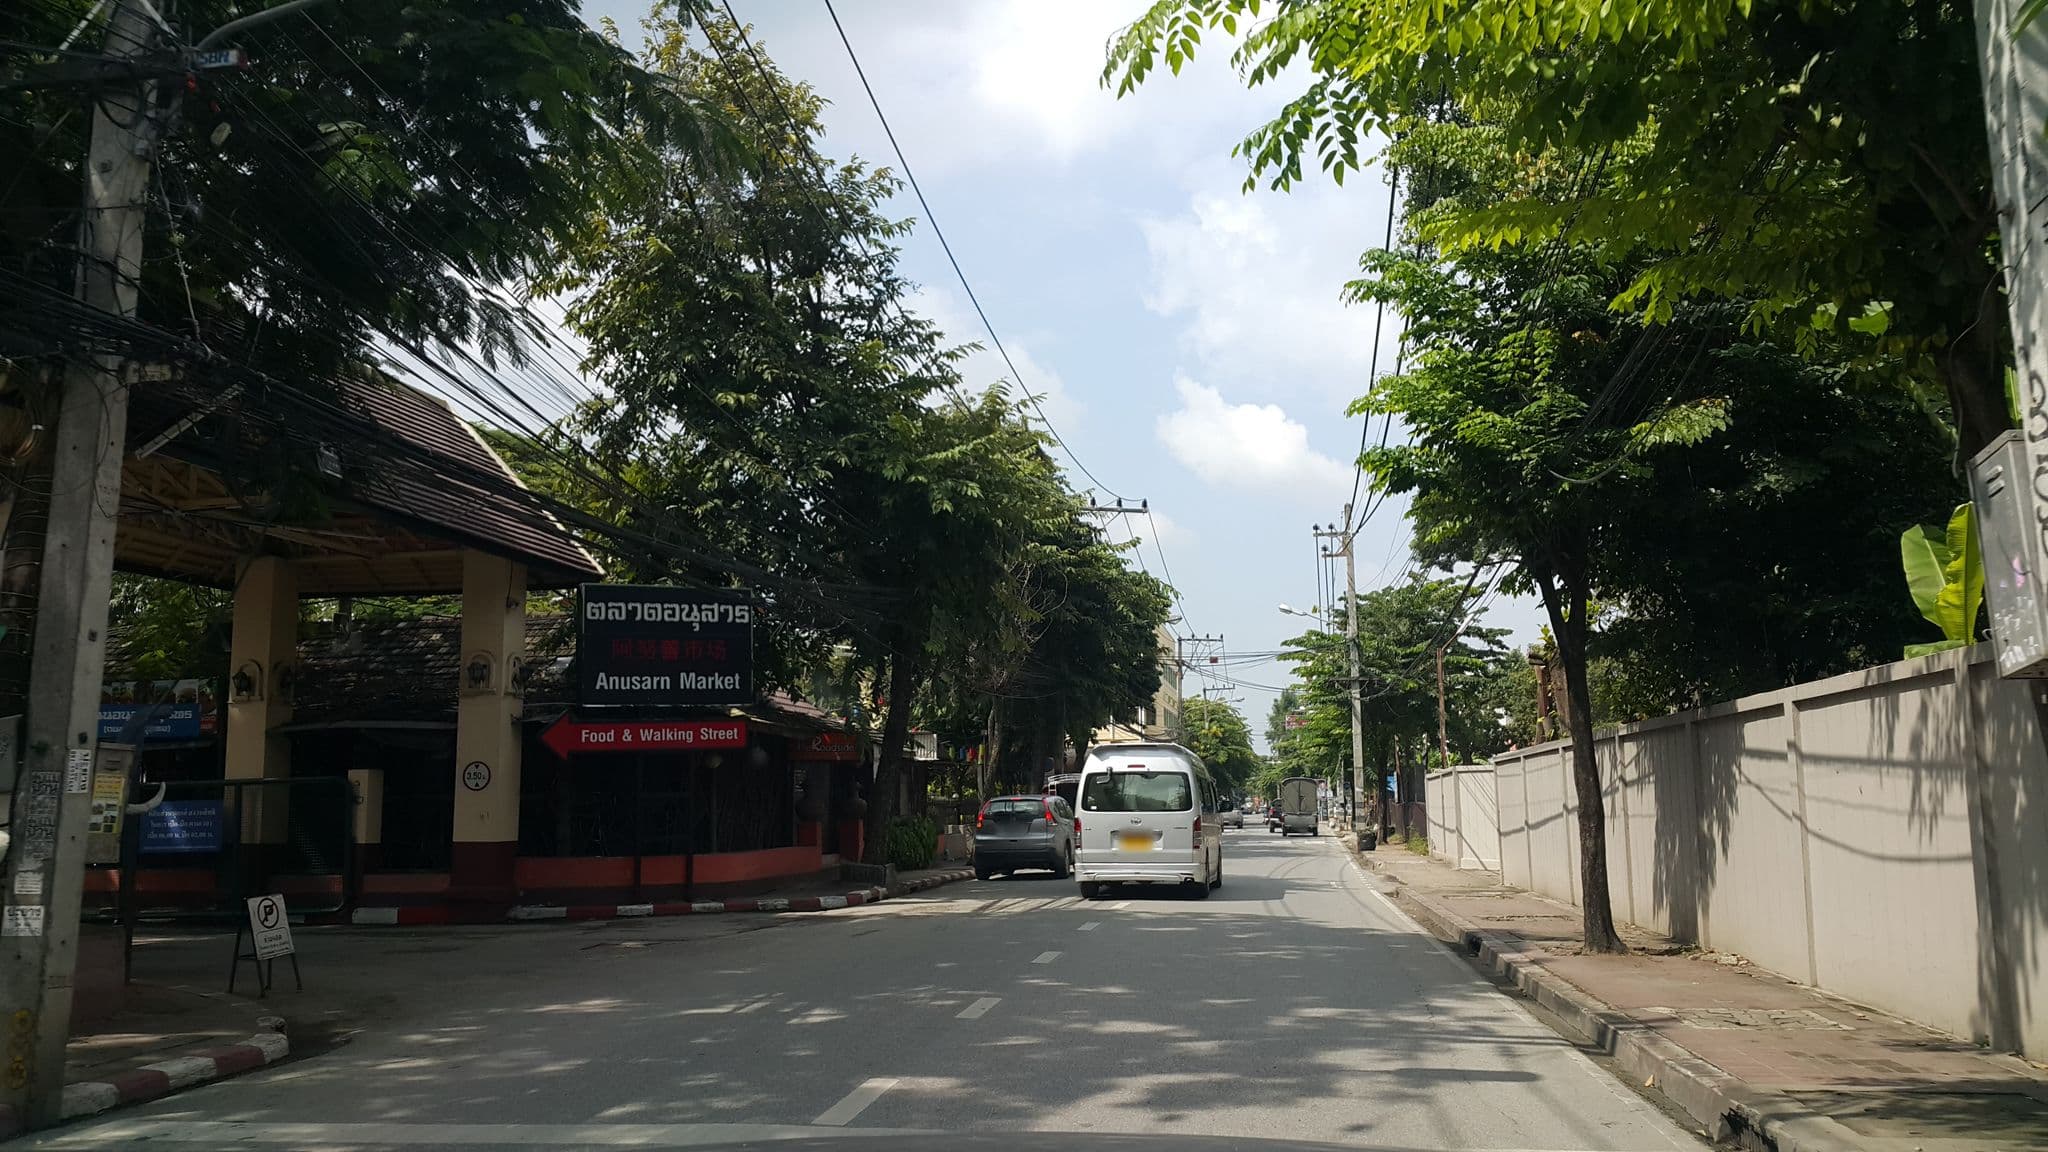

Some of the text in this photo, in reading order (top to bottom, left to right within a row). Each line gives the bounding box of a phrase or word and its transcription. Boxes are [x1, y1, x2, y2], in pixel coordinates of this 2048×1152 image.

[586, 602, 749, 631] ตลาดอนุสาร
[595, 672, 740, 690] Anusarn Market
[581, 727, 738, 743] Food & Walking Street
